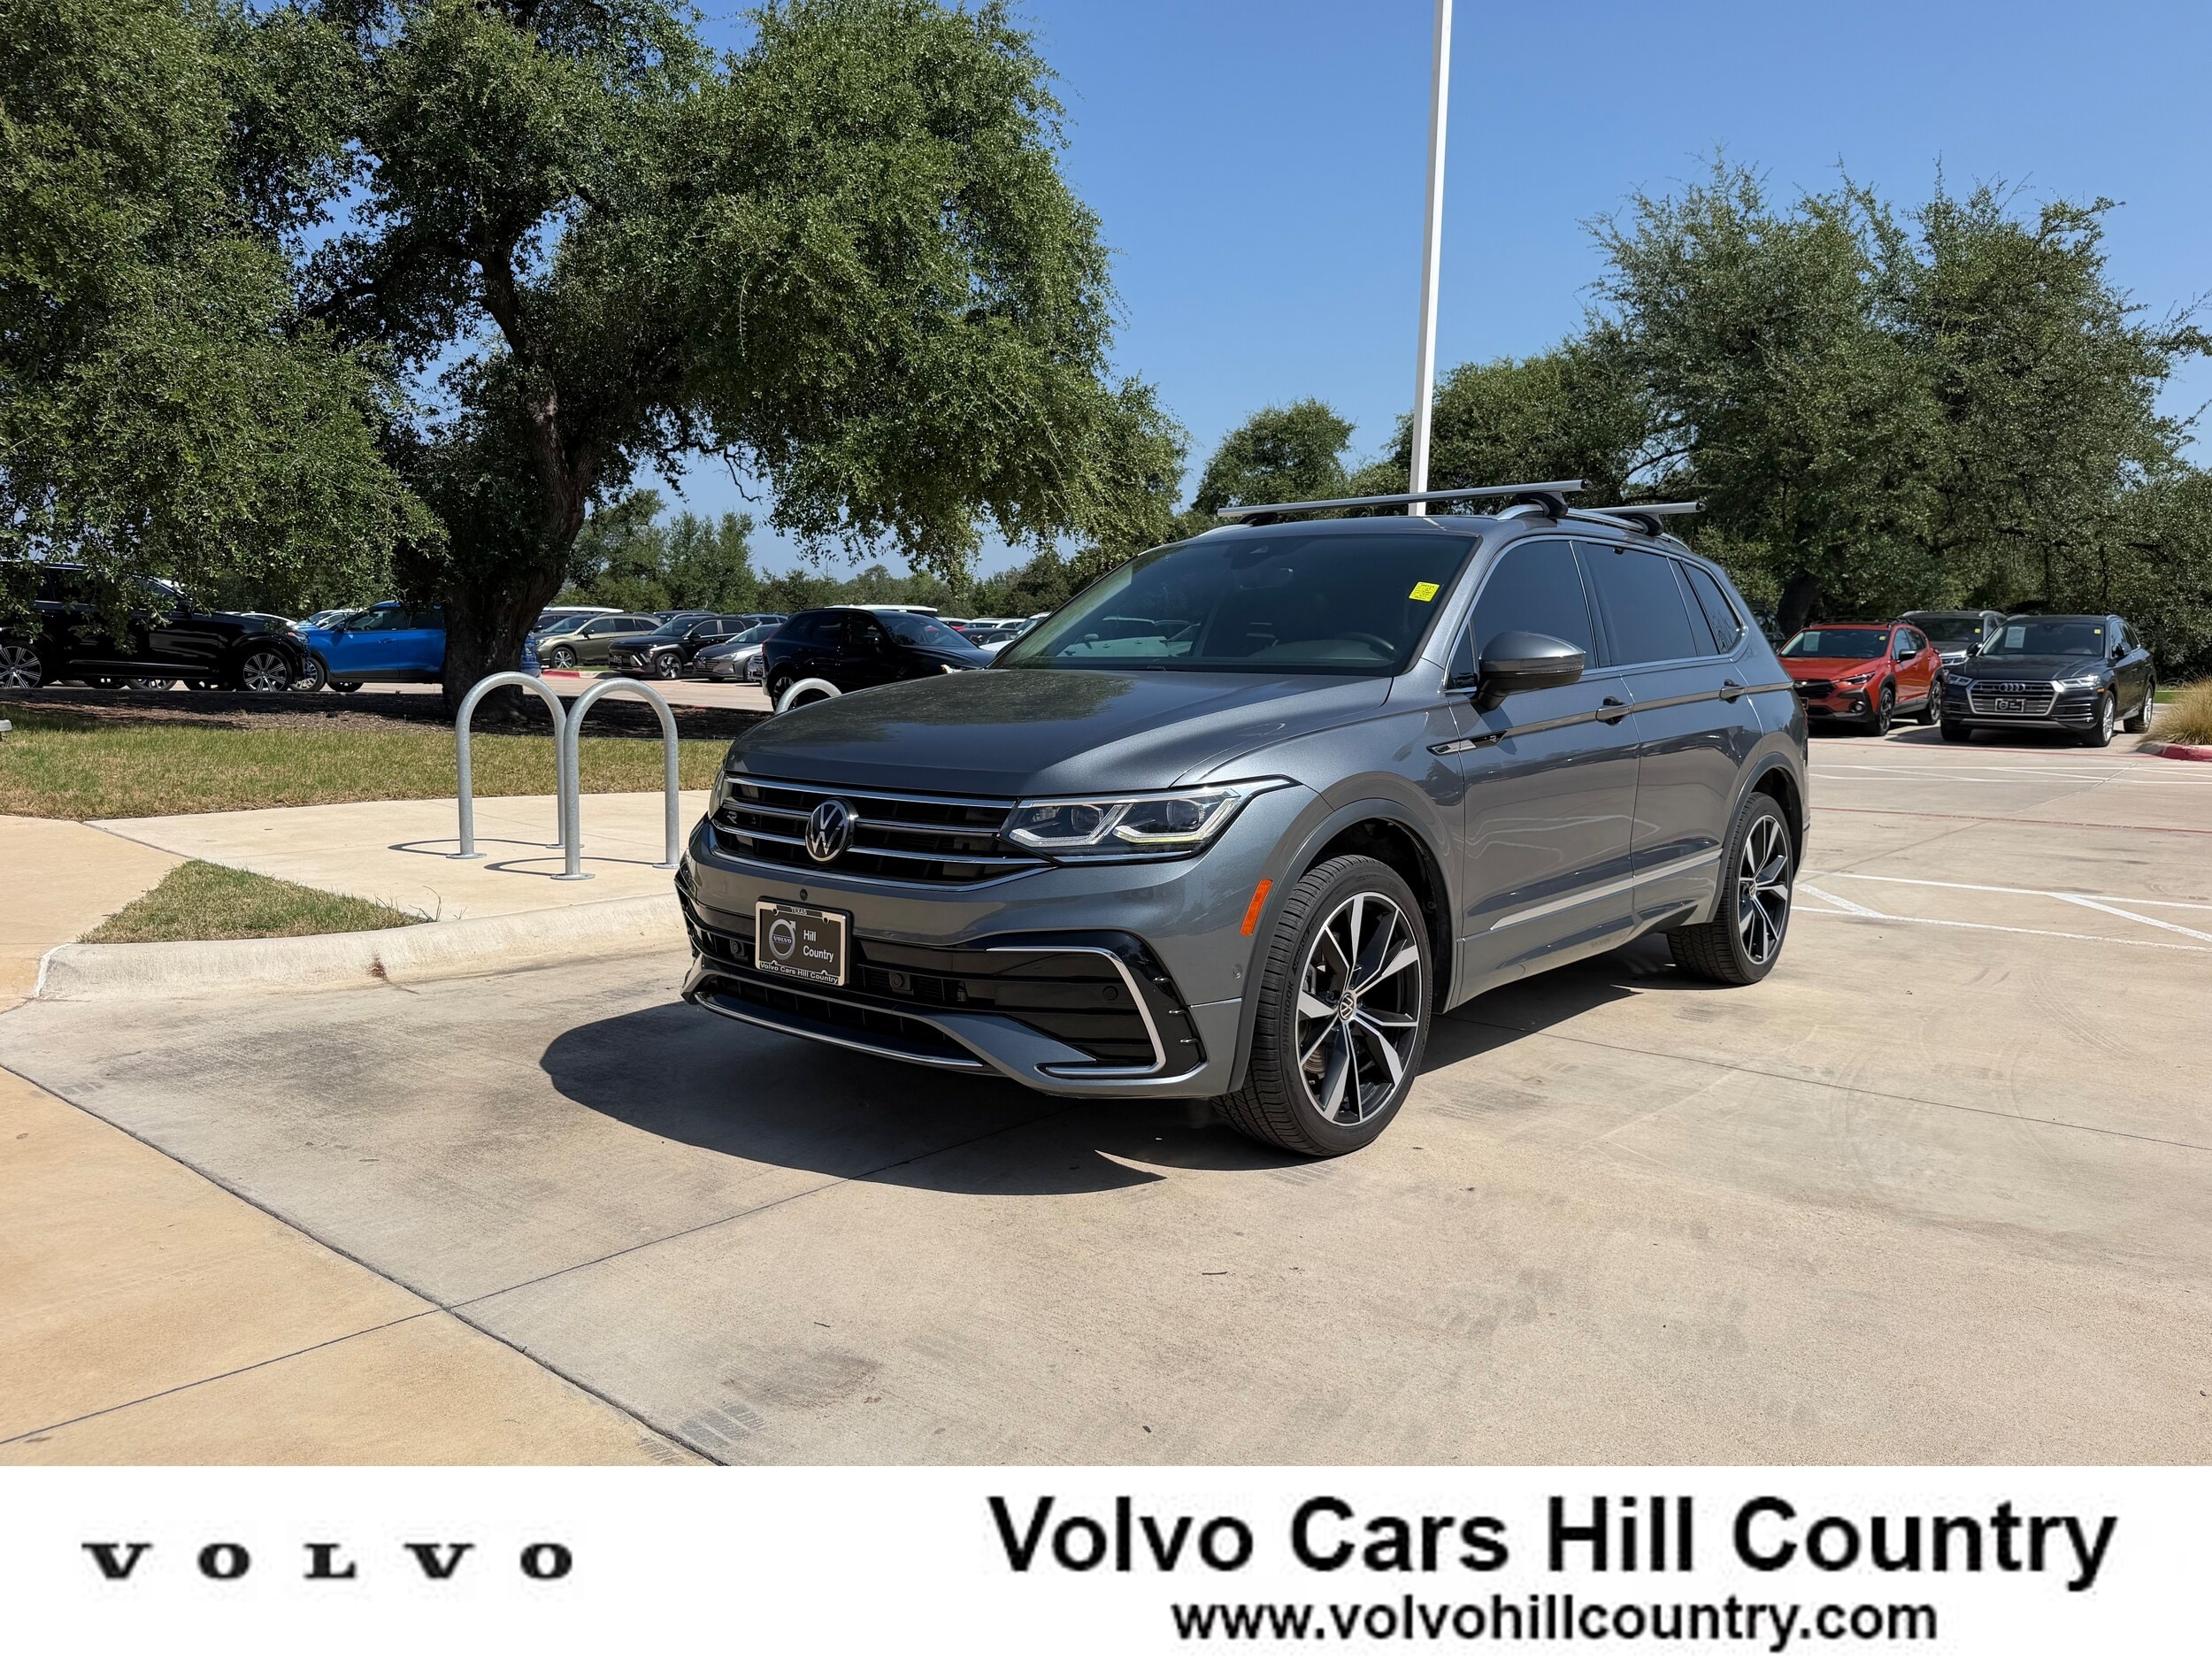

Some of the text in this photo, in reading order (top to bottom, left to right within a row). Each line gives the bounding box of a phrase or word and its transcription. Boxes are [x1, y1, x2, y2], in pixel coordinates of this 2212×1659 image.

[790, 906, 807, 916] TEXAS
[772, 935, 792, 944] VOLVO
[803, 929, 817, 942] Hill
[803, 945, 834, 963] Country
[761, 962, 838, 985] Volvo Cars Hill Country
